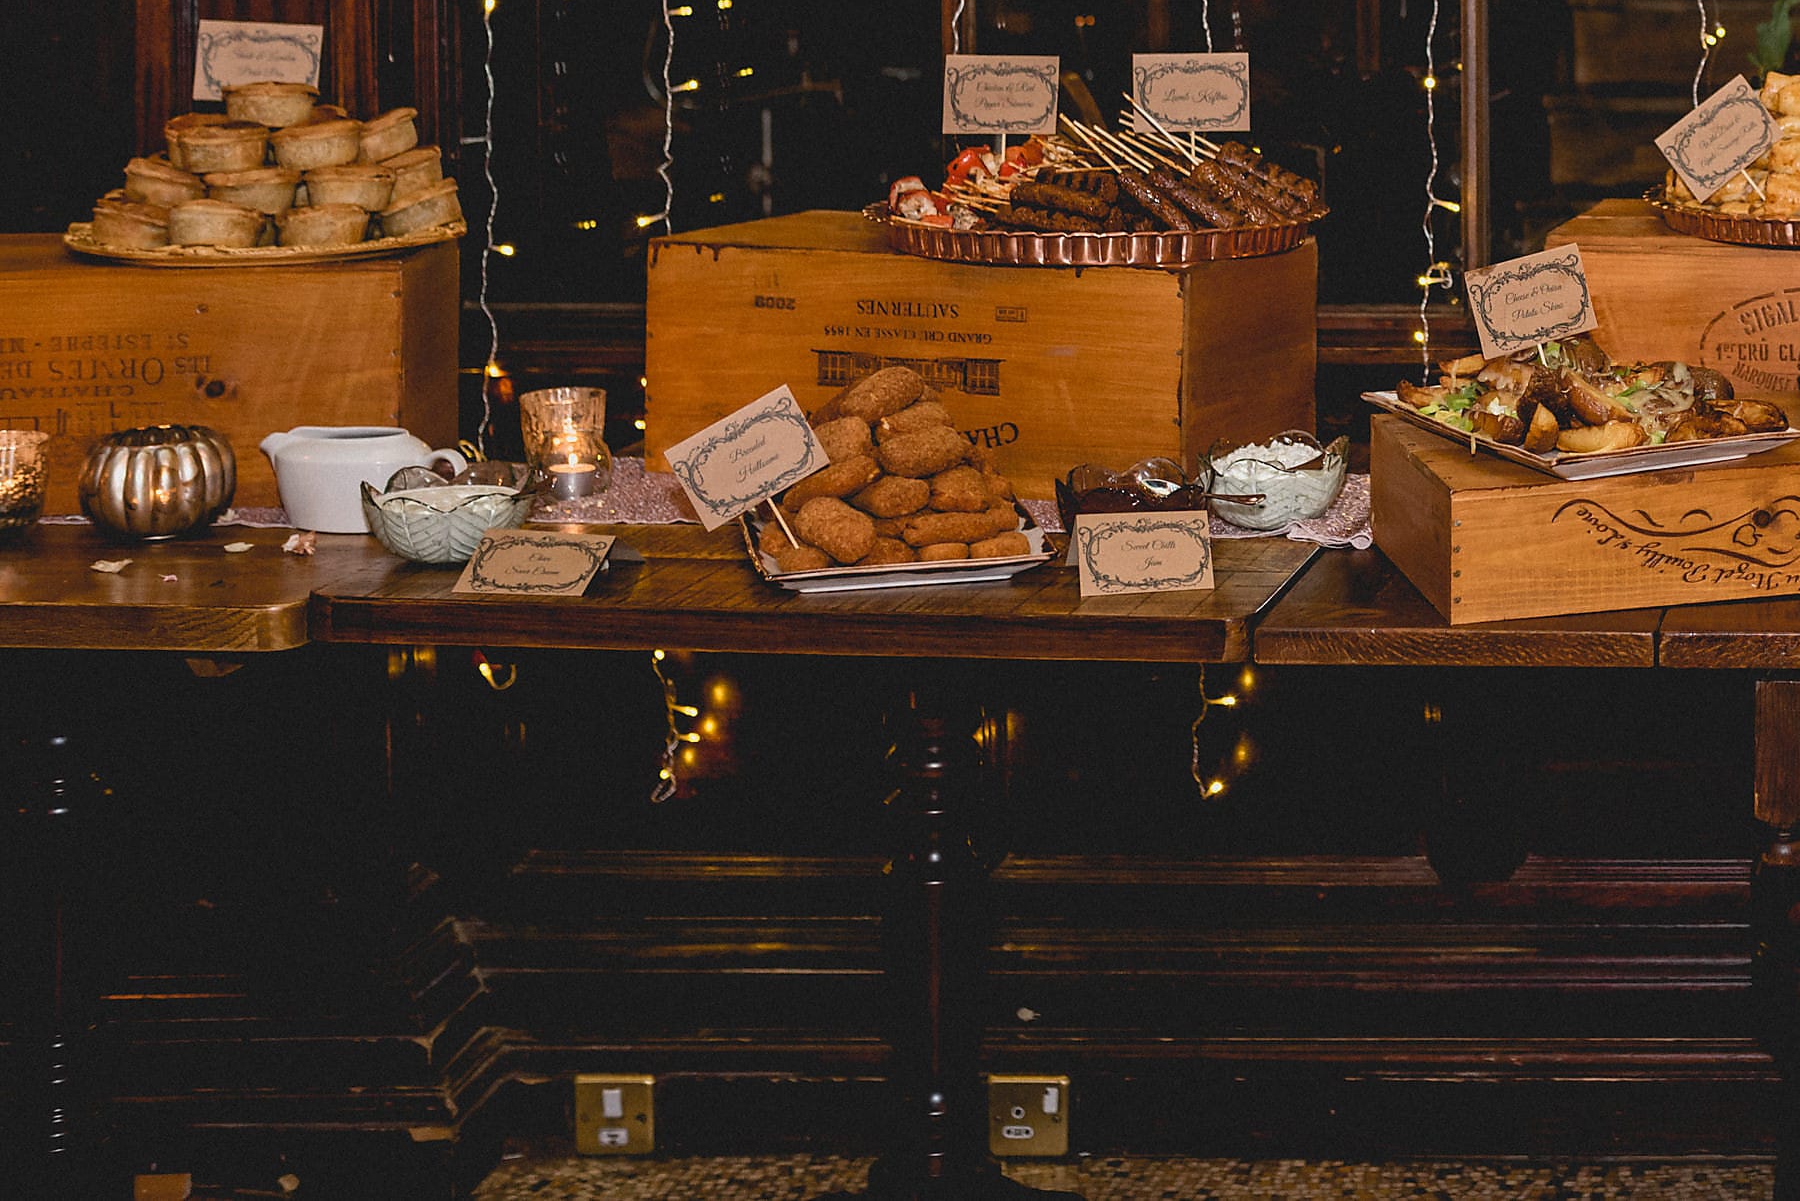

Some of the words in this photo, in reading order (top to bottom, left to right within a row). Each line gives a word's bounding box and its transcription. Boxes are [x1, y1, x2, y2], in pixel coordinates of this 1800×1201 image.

[1505, 292, 1530, 305] Cheese
[1531, 287, 1539, 296] &
[1540, 283, 1562, 295] Onion
[856, 299, 960, 319] SAUTERNES
[1511, 309, 1538, 322] Potato
[1540, 300, 1564, 315] Skins
[824, 326, 851, 337] 1855
[856, 327, 871, 339] EN
[920, 330, 944, 342] CRU
[948, 332, 992, 344] GRAND
[48, 356, 164, 386] ORMES
[1, 384, 135, 400] CHATEAU
[963, 421, 1020, 449] CHA
[728, 434, 766, 464] Breaded
[1121, 540, 1150, 552] Sweet
[1138, 556, 1162, 571] Jam
[1635, 541, 1711, 583] Pouilly
